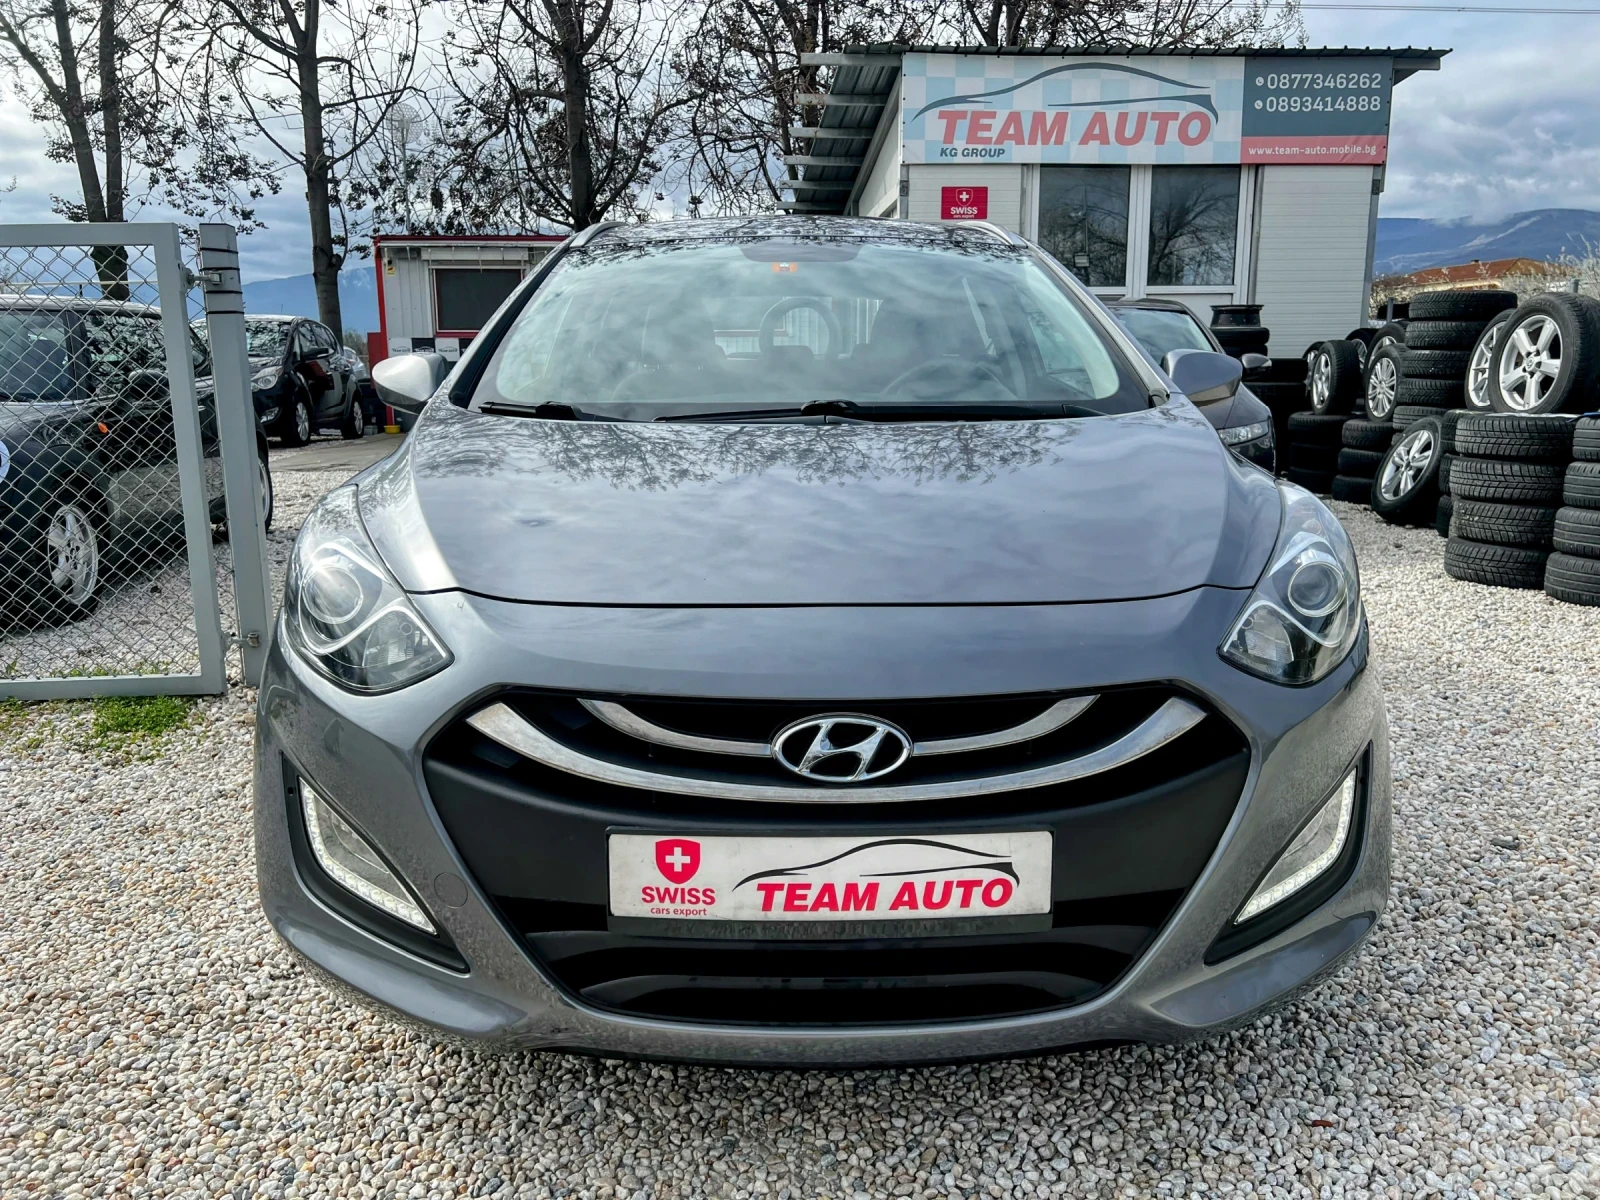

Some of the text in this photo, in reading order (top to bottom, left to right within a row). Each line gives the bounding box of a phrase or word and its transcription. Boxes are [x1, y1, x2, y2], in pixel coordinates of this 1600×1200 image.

[1267, 73, 1382, 89] 0877346262
[1266, 96, 1381, 112] 0893414888
[937, 110, 1212, 146] TEAM AUTO
[940, 147, 1006, 158] KG GROUP
[1248, 144, 1377, 156] www.team-auto.mobile.bg
[950, 206, 978, 214] SWISS
[641, 886, 716, 906] SWISS
[756, 877, 1013, 912] TEAM AUTO
[650, 907, 707, 917] cars export
